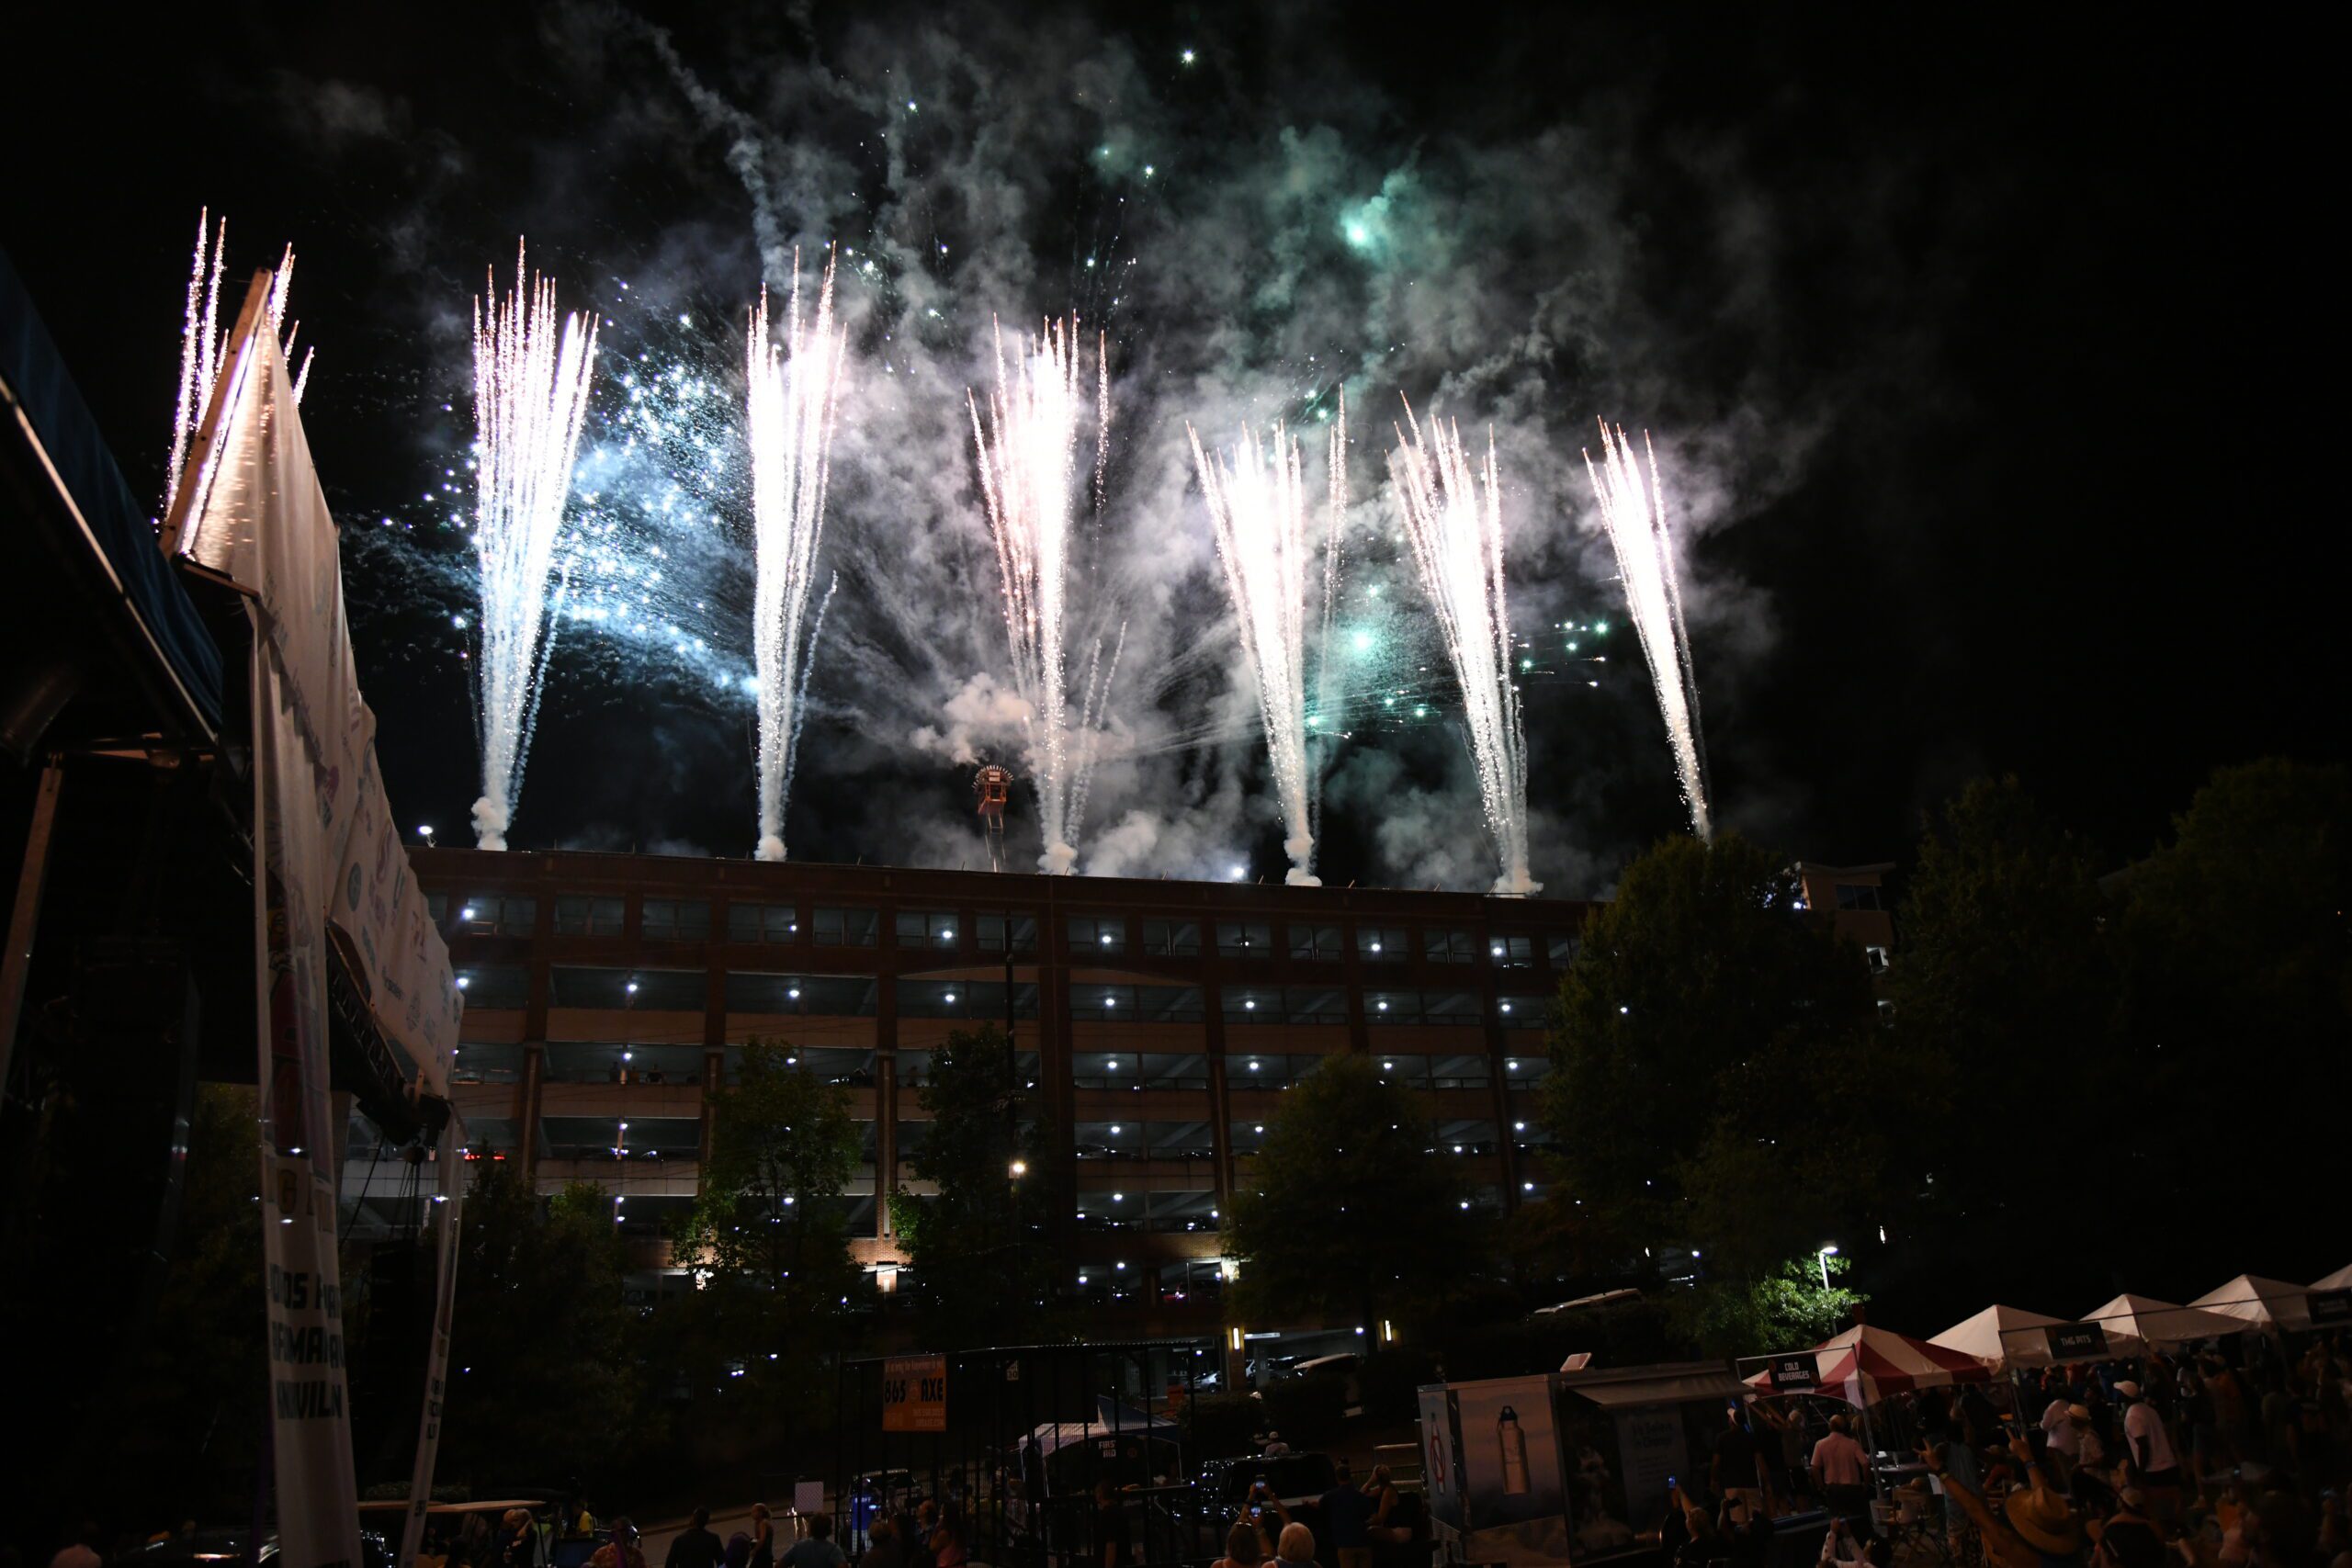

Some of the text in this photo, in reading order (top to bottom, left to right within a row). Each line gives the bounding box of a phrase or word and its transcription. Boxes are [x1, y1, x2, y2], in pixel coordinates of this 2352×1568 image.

[1784, 1361, 1800, 1371] COLD
[1778, 1371, 1810, 1382] BEVERAGES
[885, 1377, 944, 1404] 865 AXE
